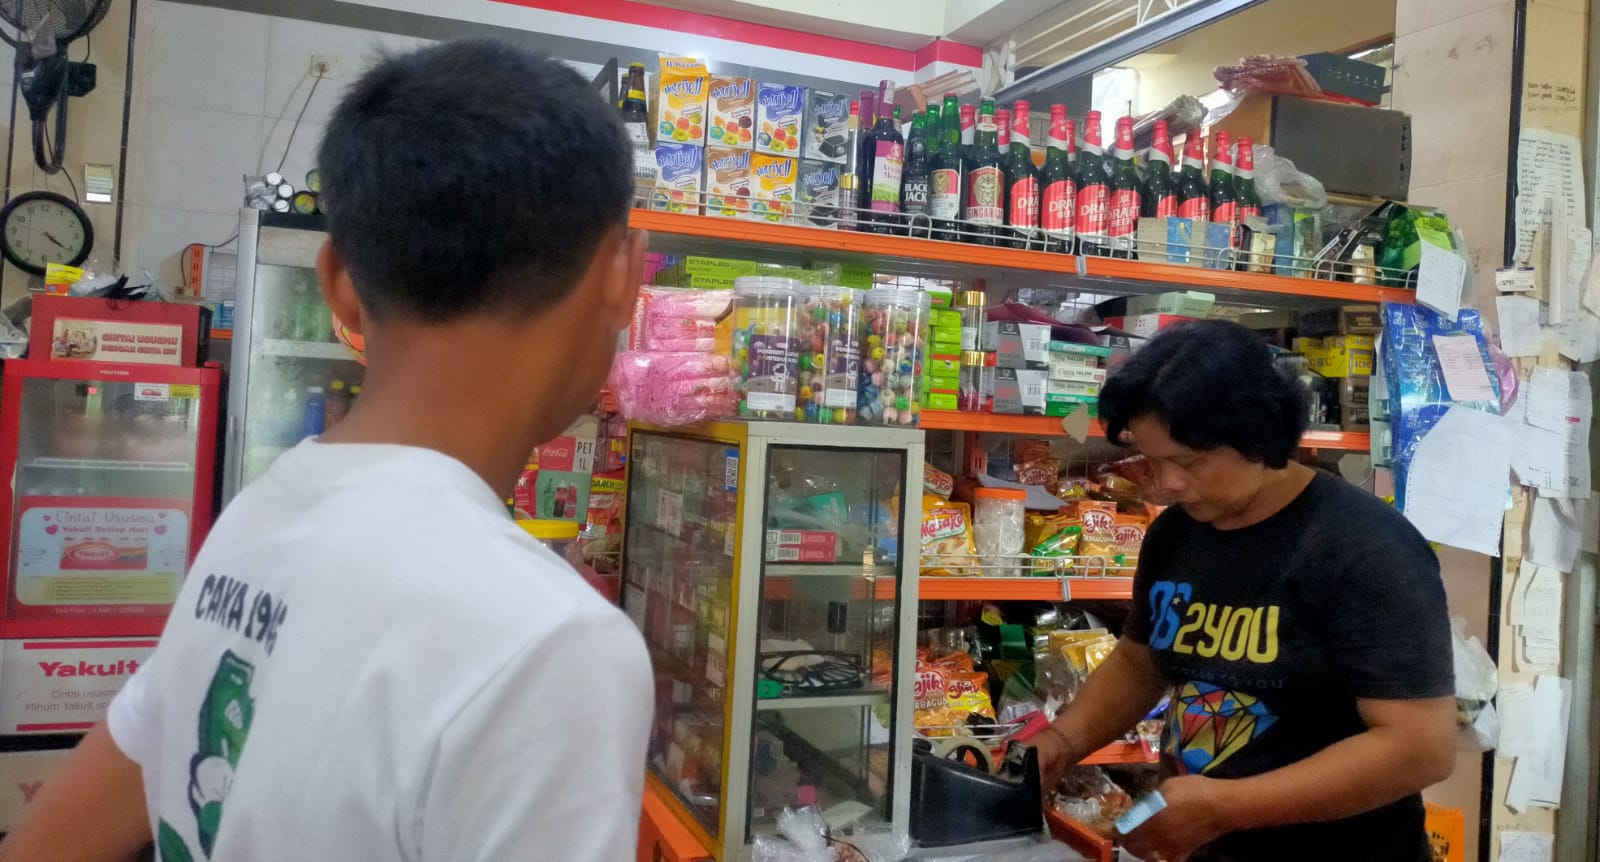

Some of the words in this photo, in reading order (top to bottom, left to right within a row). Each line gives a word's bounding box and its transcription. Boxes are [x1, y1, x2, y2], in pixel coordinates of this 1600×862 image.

[905, 192, 928, 202] JACK
[577, 441, 593, 454] PET
[579, 458, 588, 470] 1L
[38, 660, 140, 678] Yakult
[83, 690, 119, 698] ususm
